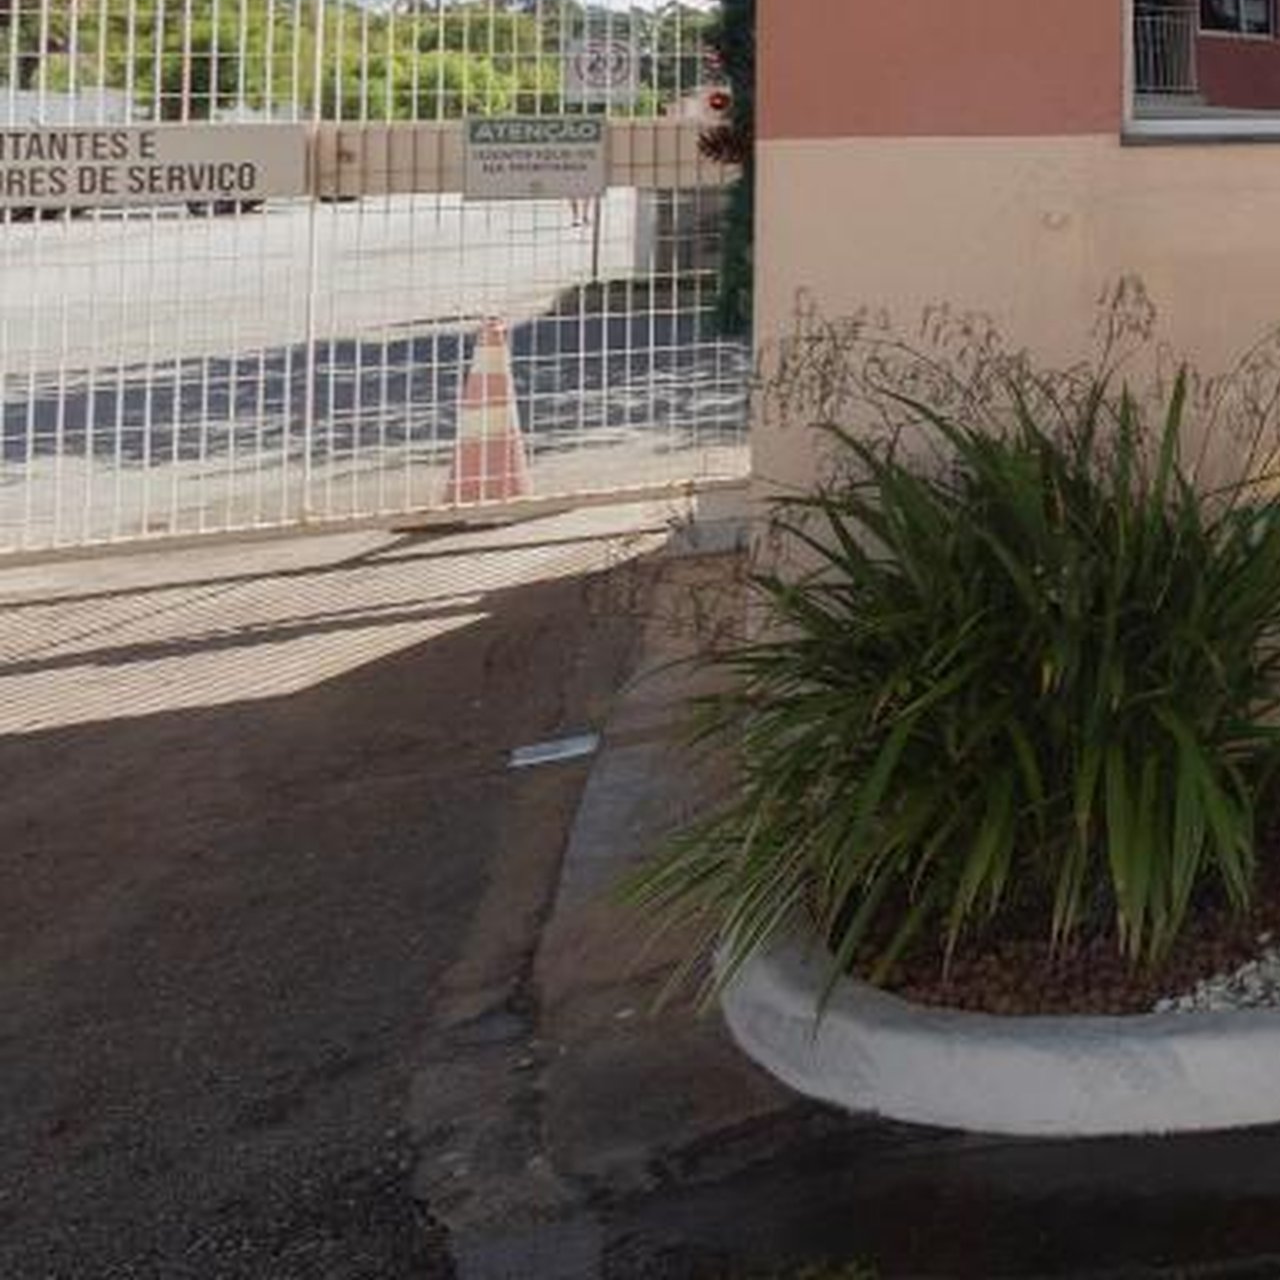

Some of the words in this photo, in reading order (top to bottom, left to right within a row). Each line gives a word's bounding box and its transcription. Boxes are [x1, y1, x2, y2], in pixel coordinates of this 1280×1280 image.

[140, 131, 156, 159] E
[0, 166, 67, 197] RES
[78, 165, 118, 195] DE
[129, 162, 257, 197] SERVIÇO
